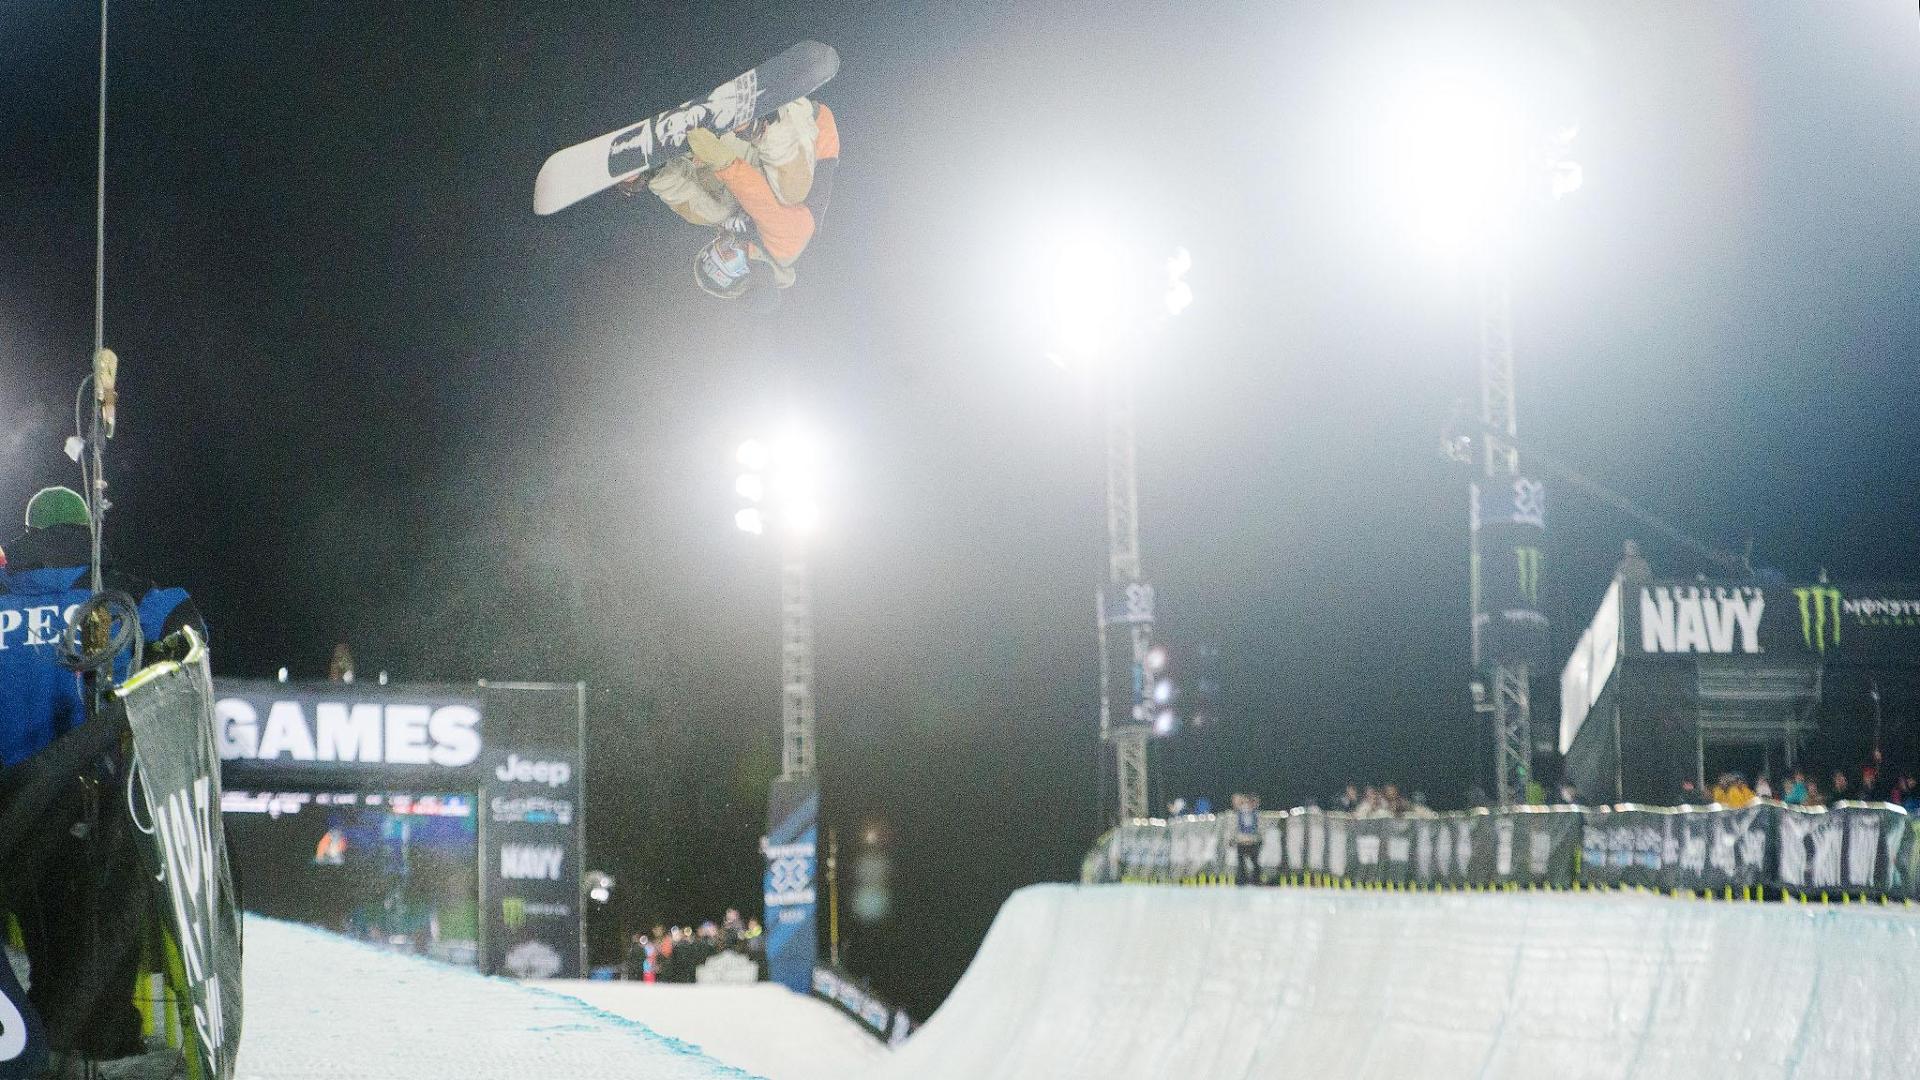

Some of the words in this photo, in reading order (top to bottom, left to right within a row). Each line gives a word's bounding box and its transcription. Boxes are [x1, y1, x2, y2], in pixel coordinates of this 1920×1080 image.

[1641, 586, 1765, 654] NAVY
[214, 698, 482, 767] GAMES
[496, 754, 571, 787] Jeep
